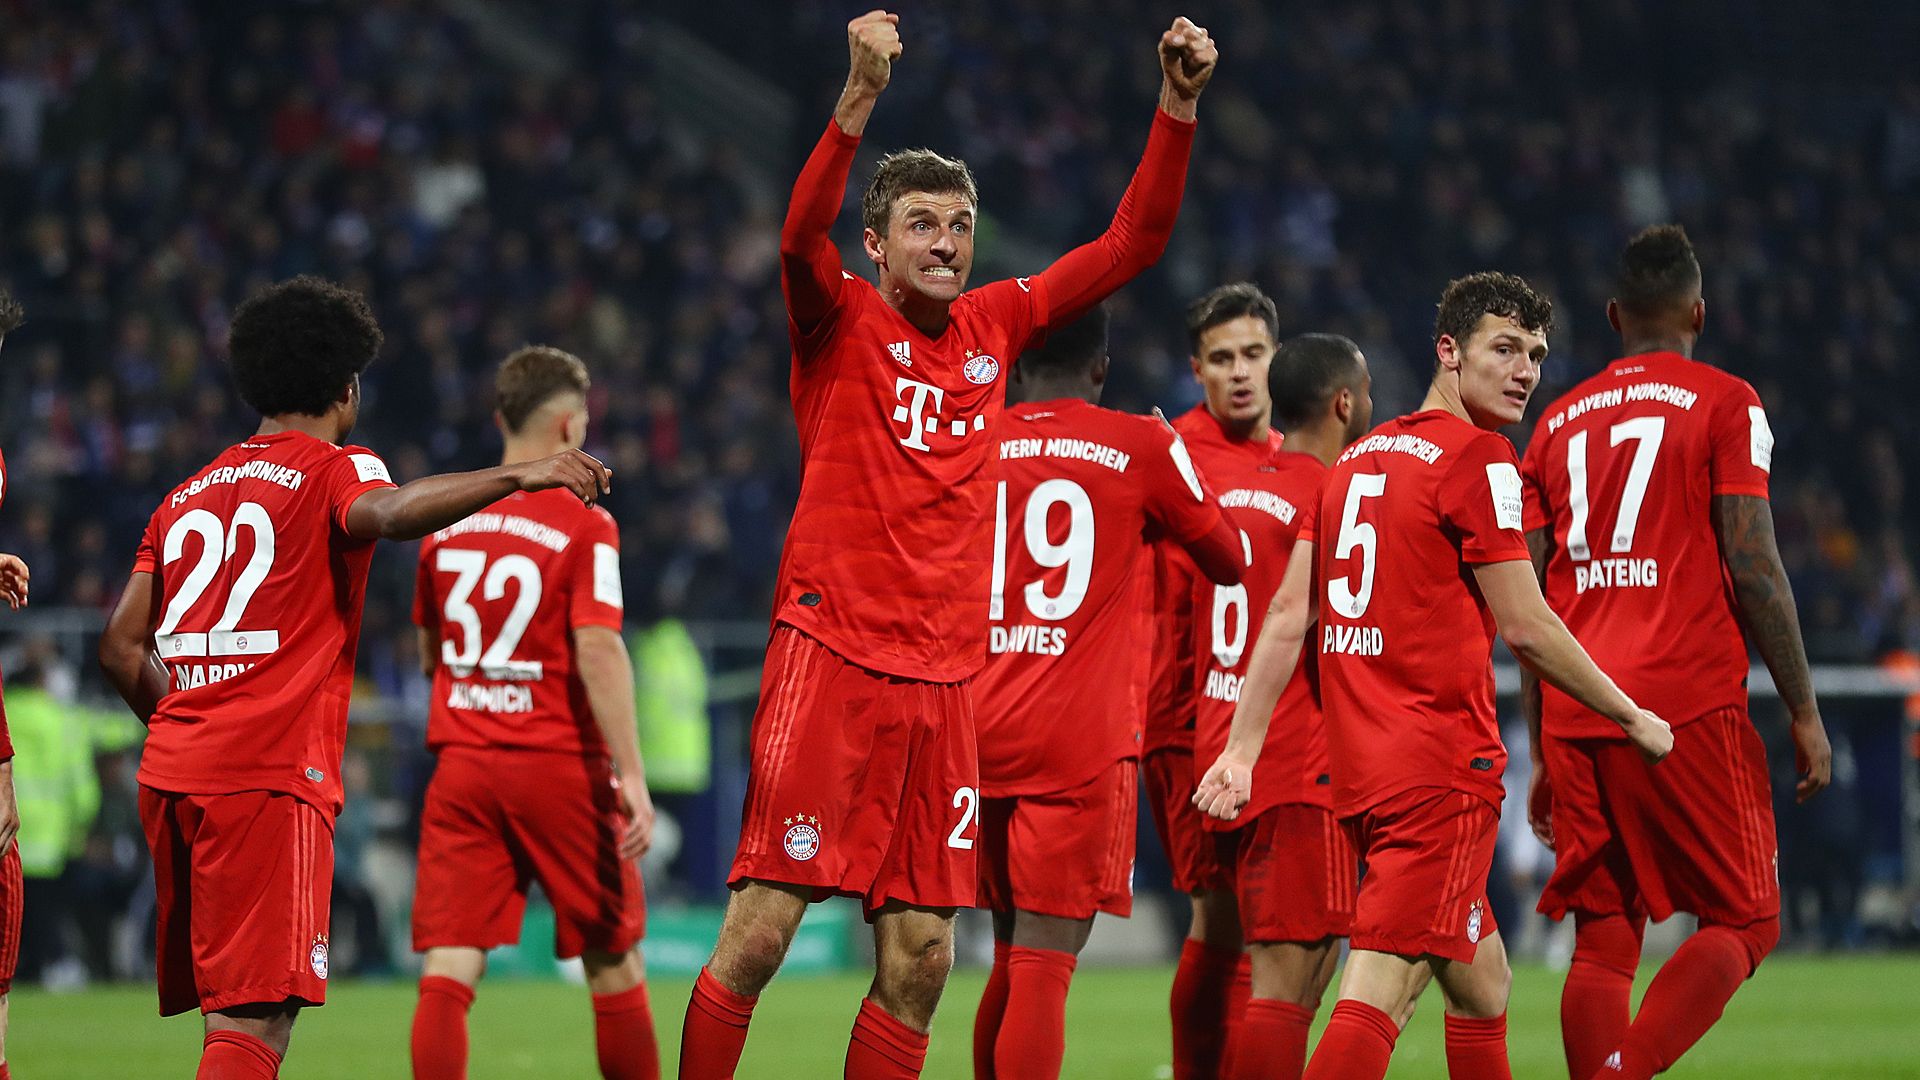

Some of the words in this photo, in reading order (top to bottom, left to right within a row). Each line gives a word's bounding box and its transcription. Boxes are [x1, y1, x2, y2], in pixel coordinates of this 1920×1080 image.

[1568, 388, 1623, 421] BAYERN
[171, 487, 190, 508] FC
[1000, 438, 1043, 460] YERN
[1044, 438, 1131, 473] MÜNCHEN
[1568, 417, 1665, 561] 17
[155, 502, 279, 659] 22
[989, 478, 1095, 620] 19
[1327, 473, 1387, 618] 5
[437, 549, 542, 680] 32
[990, 625, 1067, 656] DAVIES
[948, 787, 979, 849] 2
